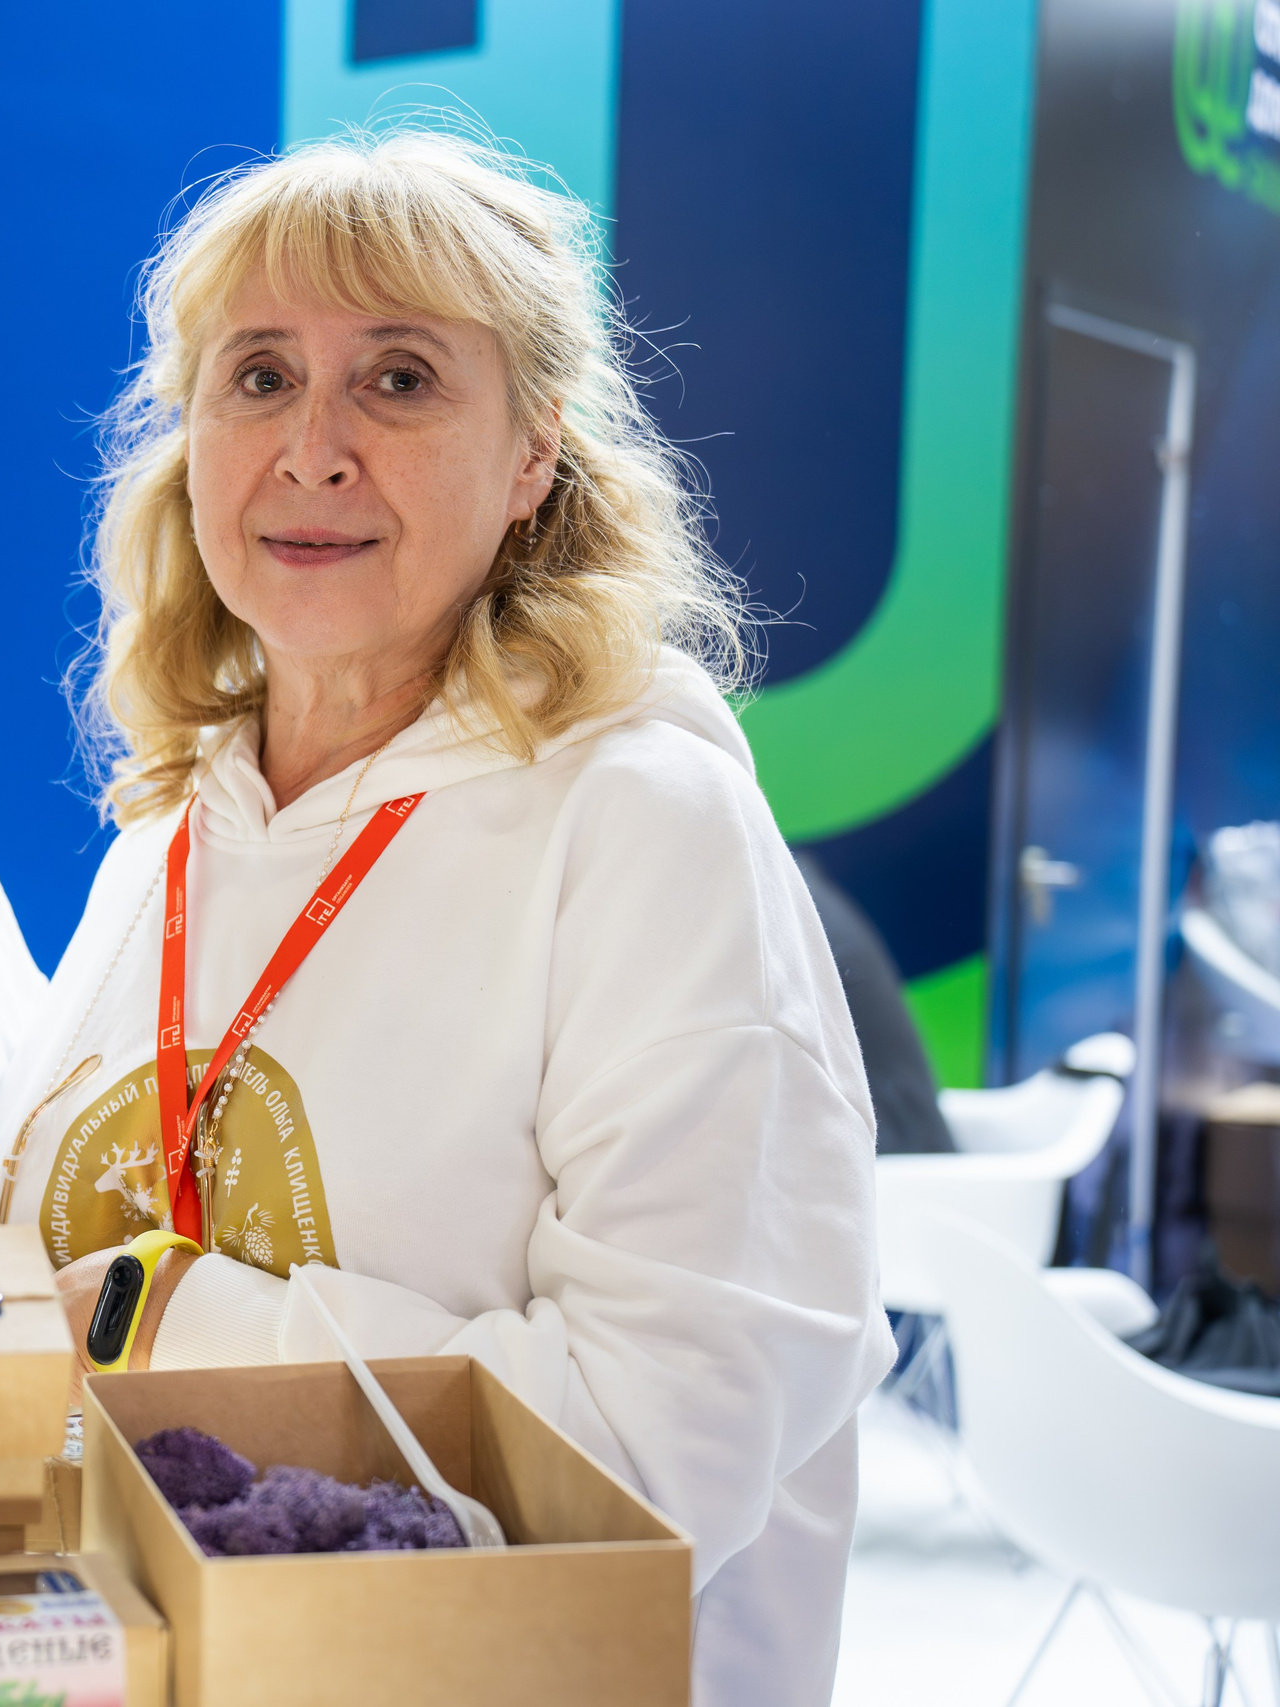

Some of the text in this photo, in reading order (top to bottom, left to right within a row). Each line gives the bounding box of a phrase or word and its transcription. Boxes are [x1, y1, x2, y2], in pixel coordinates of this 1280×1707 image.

[316, 908, 332, 926] ITE
[51, 1082, 140, 1264] ИНДИВИДУАЛЬНЫЙ
[265, 1090, 295, 1143] ОЛЬГА
